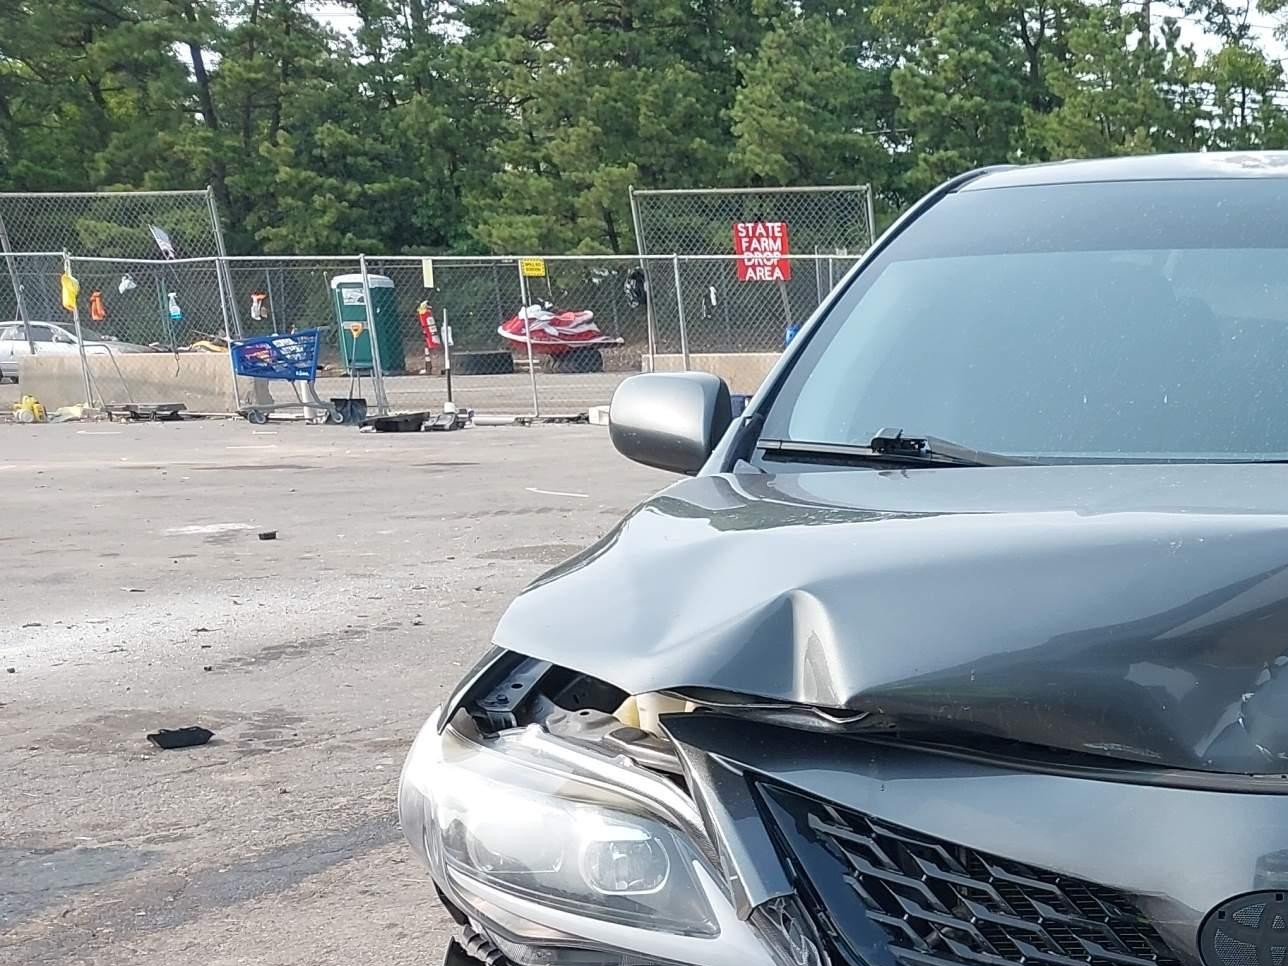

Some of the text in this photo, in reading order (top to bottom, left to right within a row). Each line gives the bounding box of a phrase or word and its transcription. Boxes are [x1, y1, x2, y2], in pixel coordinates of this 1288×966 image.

[737, 223, 783, 237] STATE
[741, 238, 783, 251] FARM
[743, 252, 782, 266] DROP
[745, 266, 785, 281] AREA
